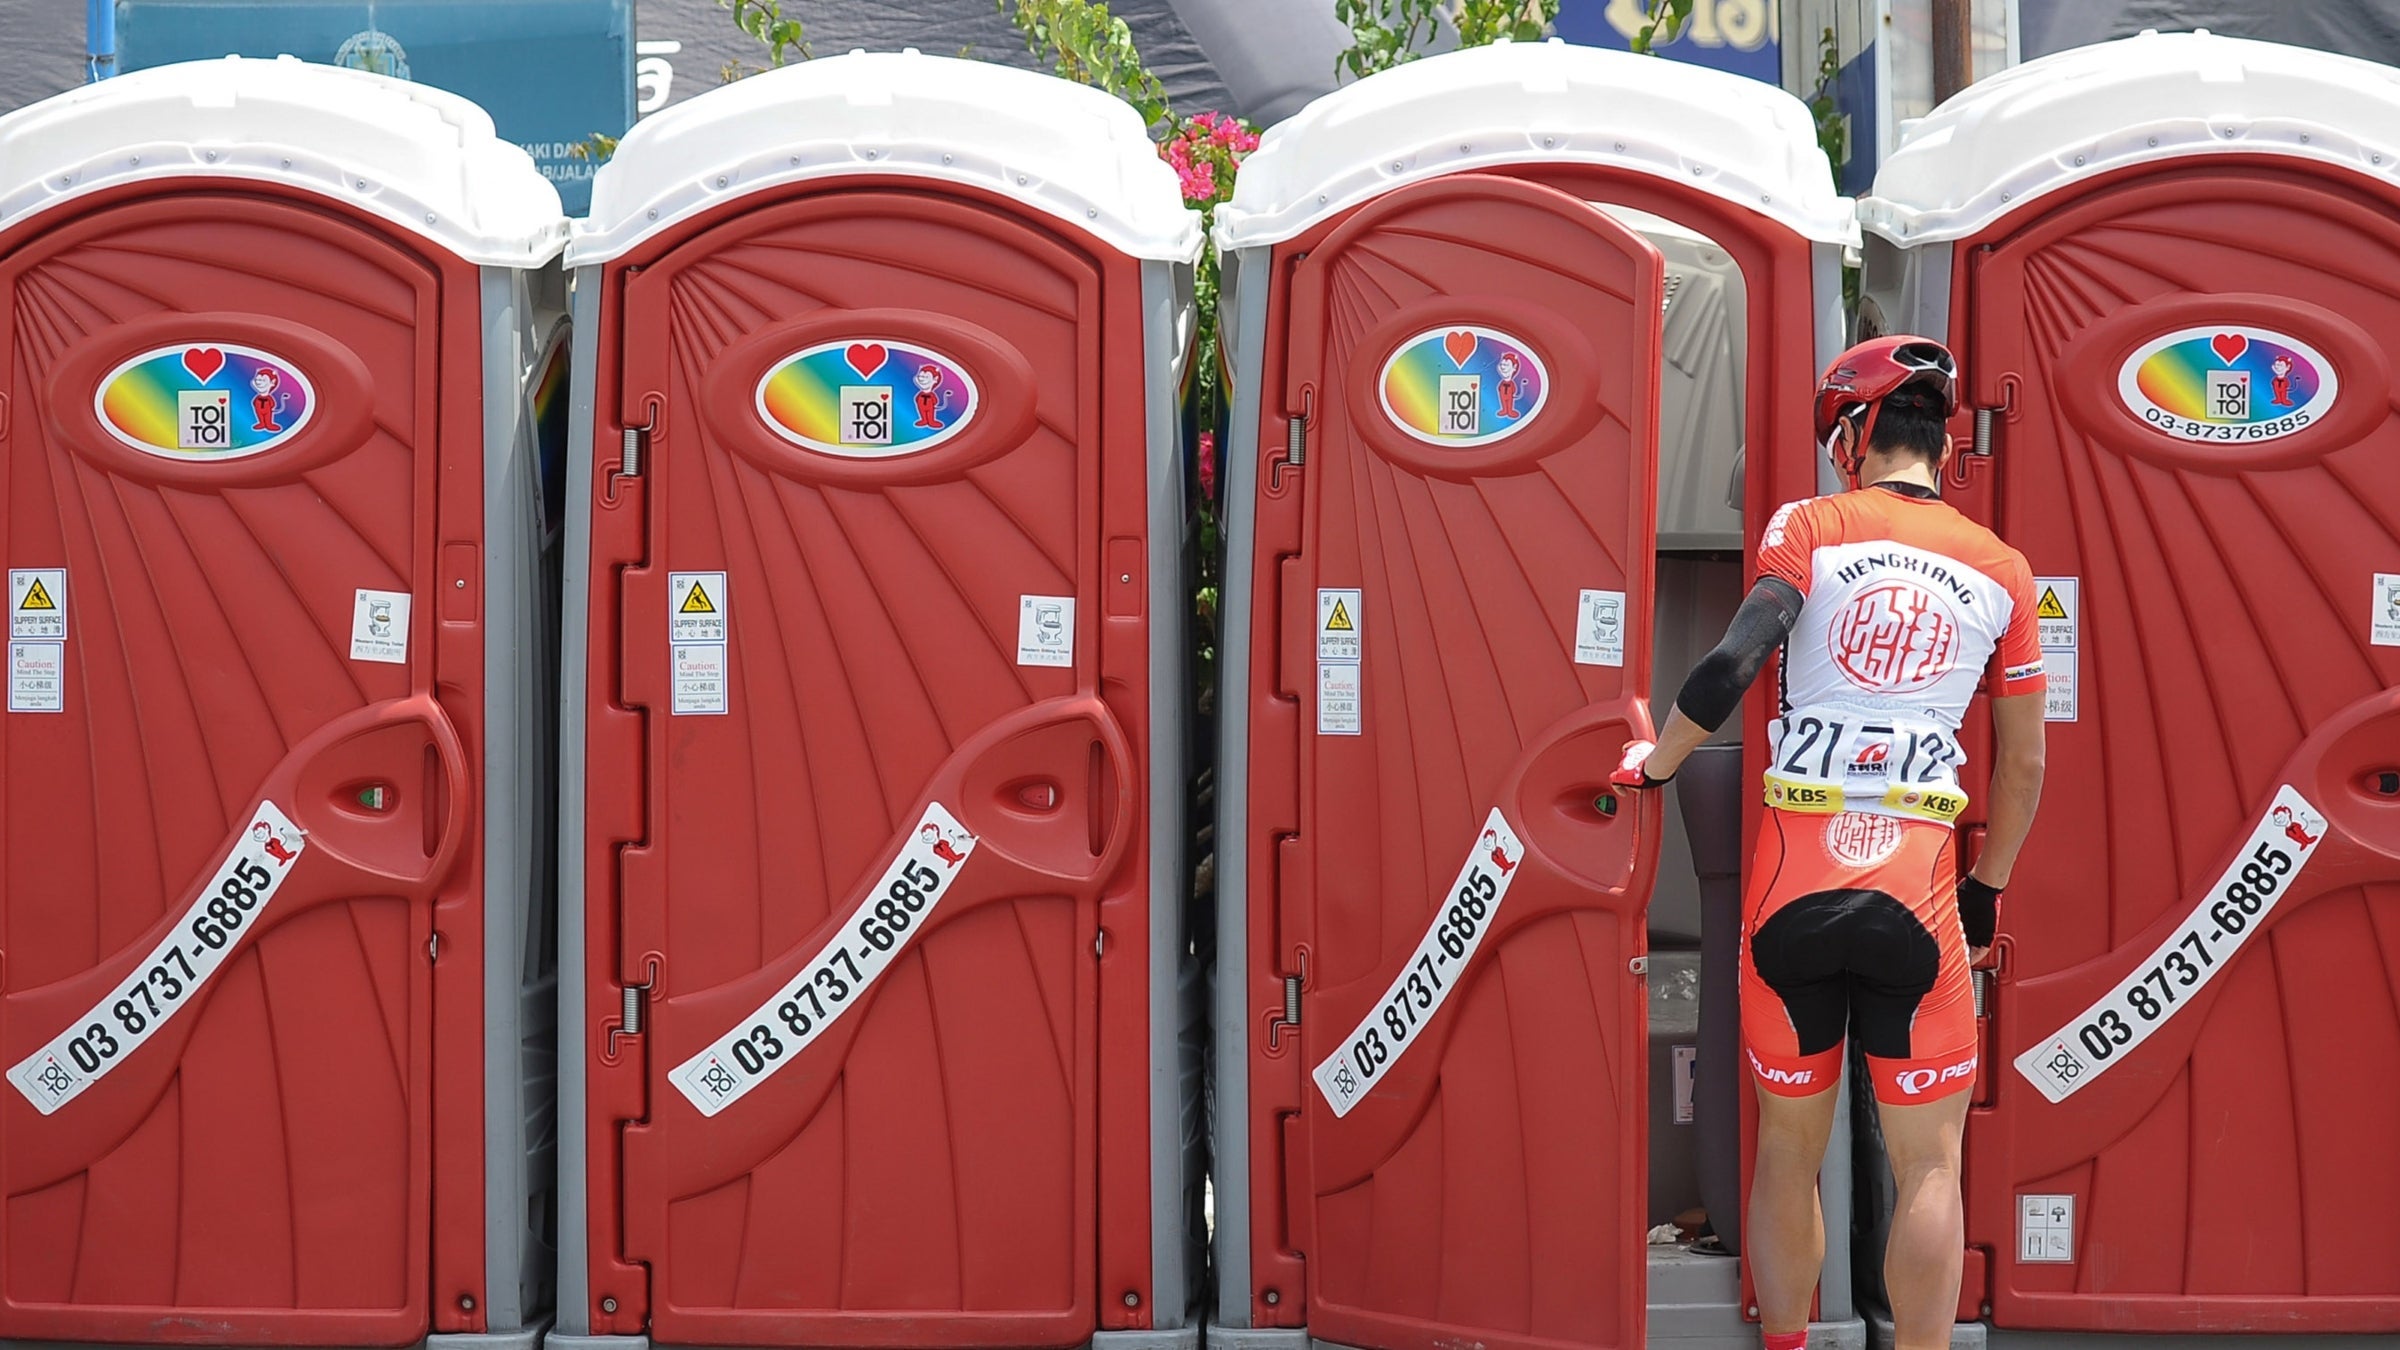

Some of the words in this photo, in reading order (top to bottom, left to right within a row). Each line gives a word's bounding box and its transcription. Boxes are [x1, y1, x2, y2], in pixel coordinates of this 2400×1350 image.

[523, 142, 551, 159] AKI
[1448, 391, 1476, 410] TOI
[2216, 383, 2246, 399] TOI
[190, 406, 225, 424] TOI
[852, 402, 887, 420] TOI
[2216, 400, 2246, 416] TOI
[852, 421, 887, 440] TOI
[1448, 411, 1476, 430] TOI
[2145, 408, 2310, 440] 03-87376885
[190, 426, 225, 444] TOI
[1837, 553, 1975, 605] HENGXIANG
[2047, 673, 2071, 683] tion:
[1787, 787, 1828, 802] KBS
[1923, 794, 1958, 813] KBS
[2078, 1009, 2132, 1060] 03
[2126, 841, 2292, 1020] 8737-6885
[68, 1023, 118, 1073] 03
[113, 857, 271, 1034] 8737-6885
[731, 1025, 783, 1075] 03
[778, 859, 940, 1036] 8737-6885
[1353, 1027, 1388, 1079] 03
[1383, 865, 1497, 1042] 8737-6885
[2046, 1049, 2073, 1073] TOI
[2057, 1059, 2084, 1084] TOI
[37, 1062, 63, 1085] TOI
[48, 1072, 73, 1096] TOI
[700, 1063, 726, 1087] TOI
[1333, 1063, 1351, 1088] TOI
[711, 1073, 736, 1098] TOI
[1340, 1075, 1358, 1099] TOI
